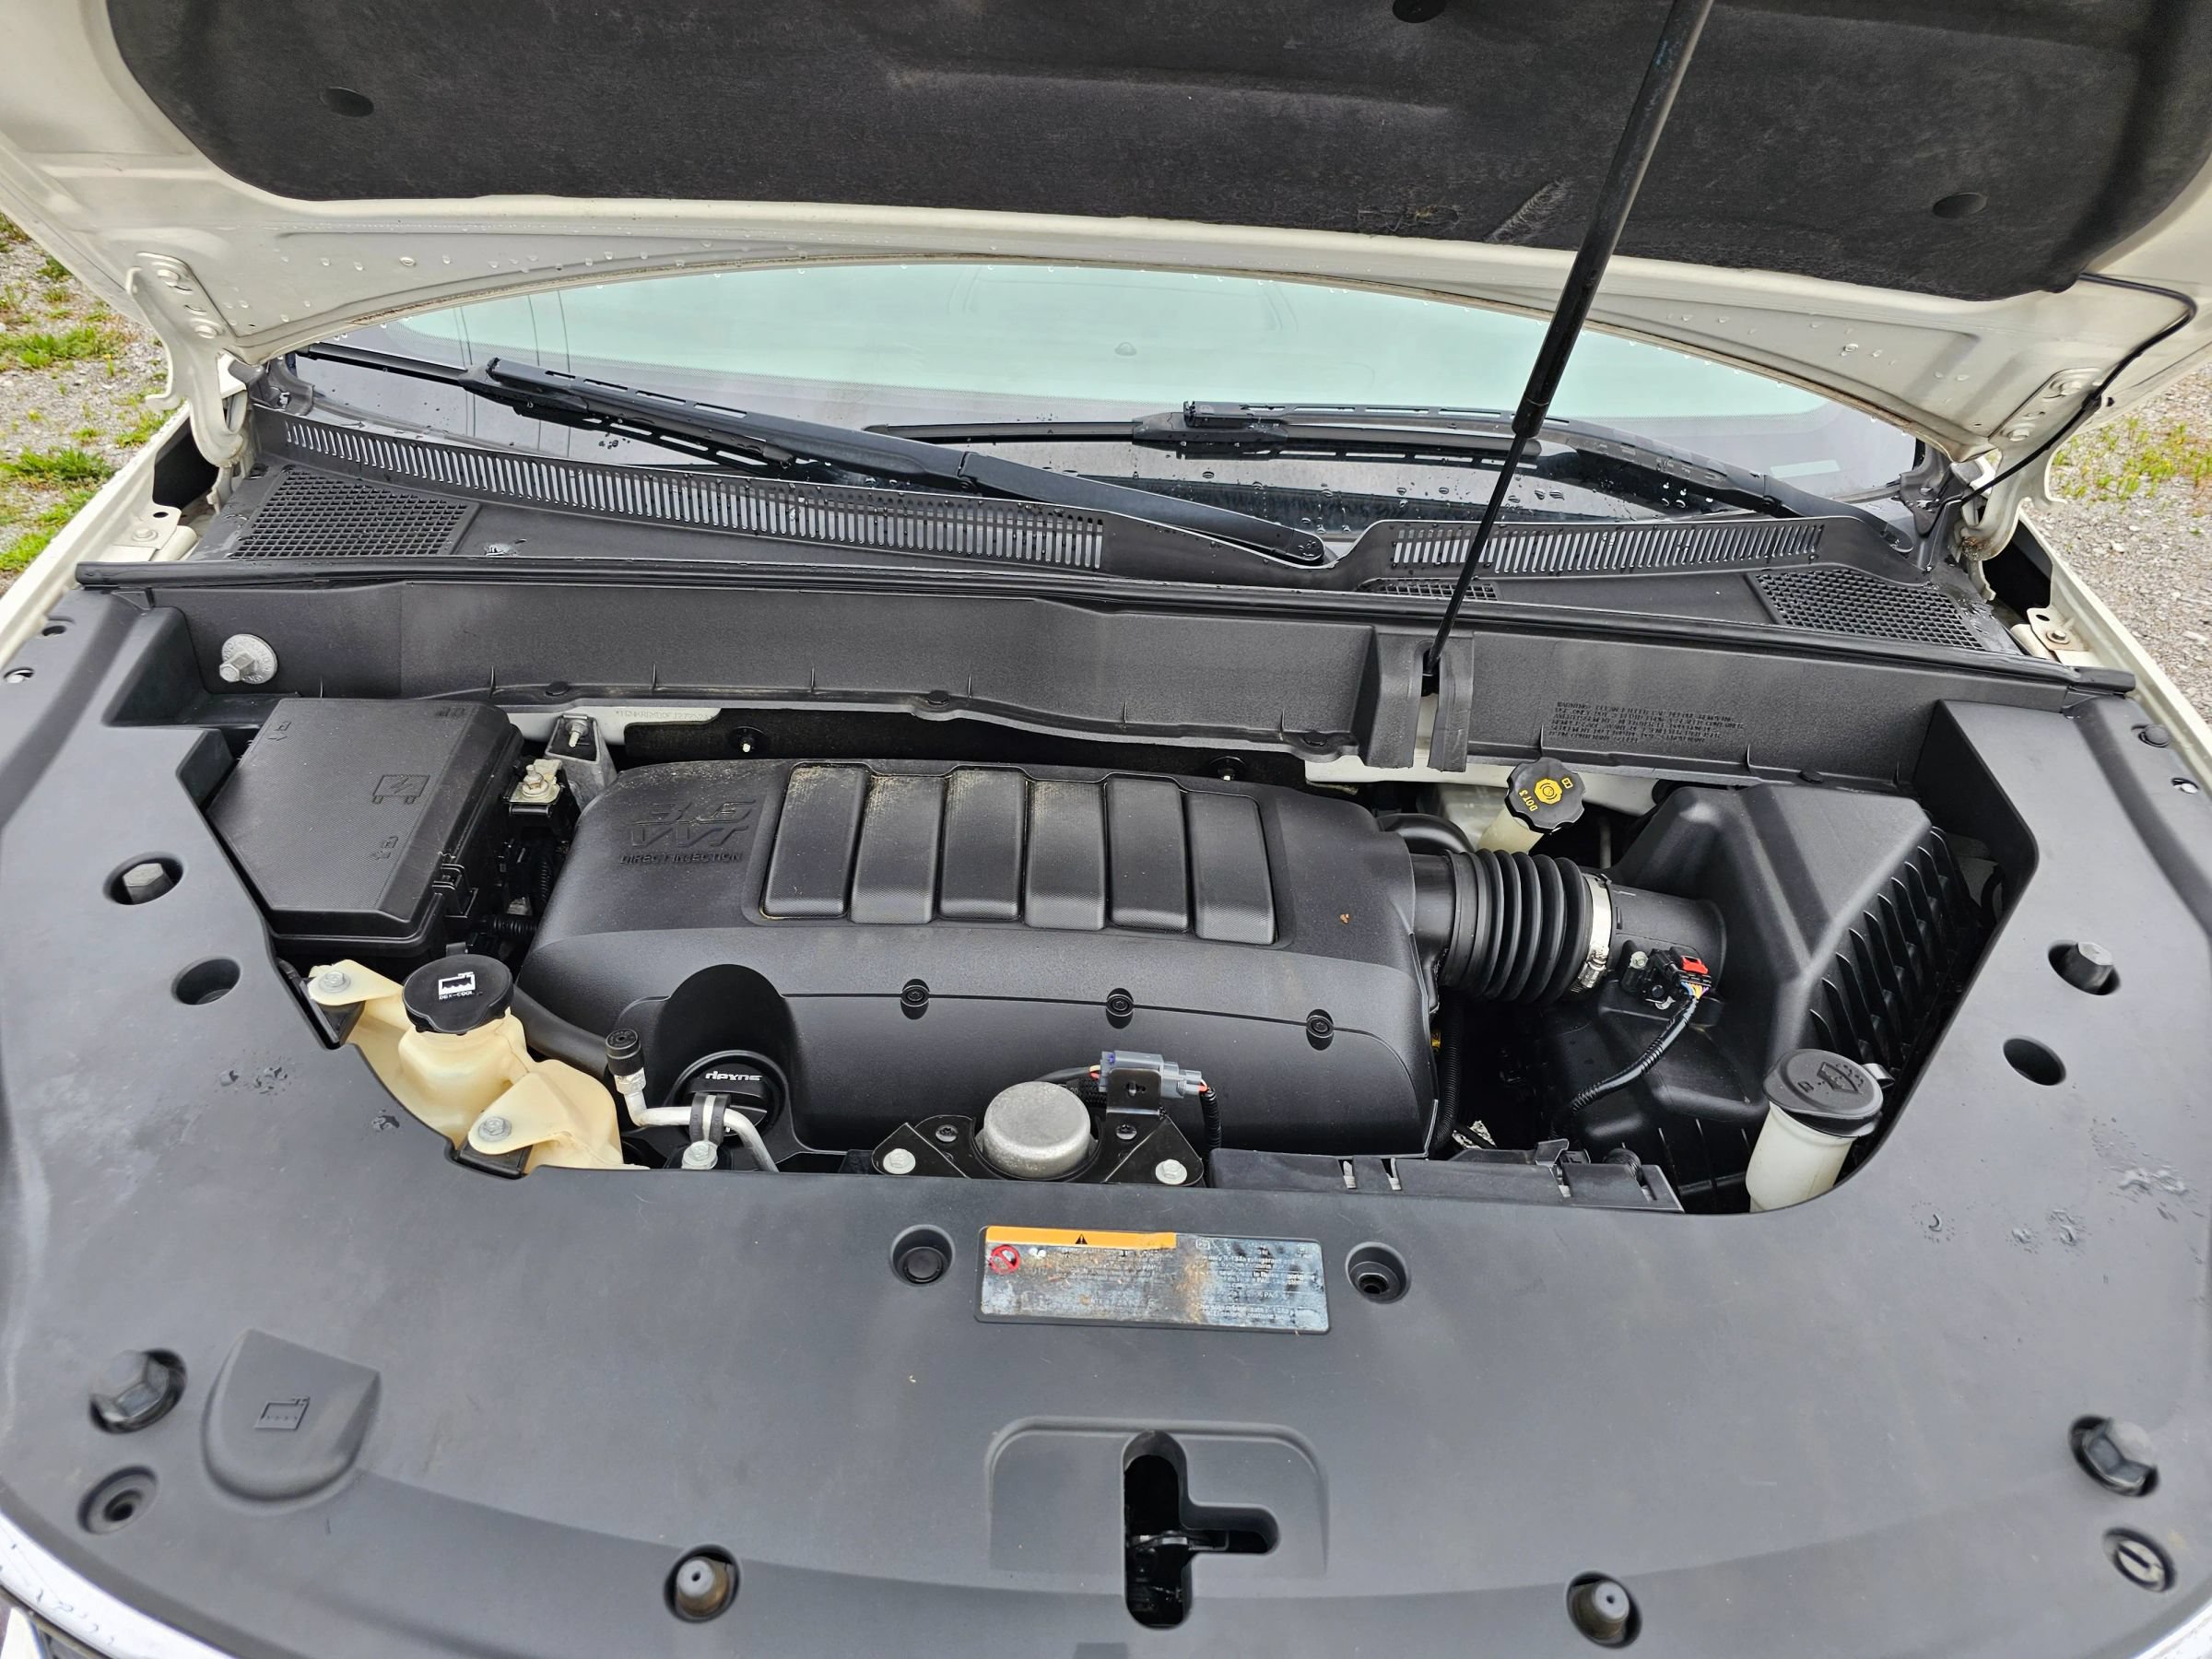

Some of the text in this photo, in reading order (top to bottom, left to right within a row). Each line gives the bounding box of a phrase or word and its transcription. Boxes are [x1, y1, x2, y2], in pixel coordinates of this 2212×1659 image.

[1518, 789, 1538, 812] DOT 3
[618, 852, 743, 865] DIRECT INJECTION
